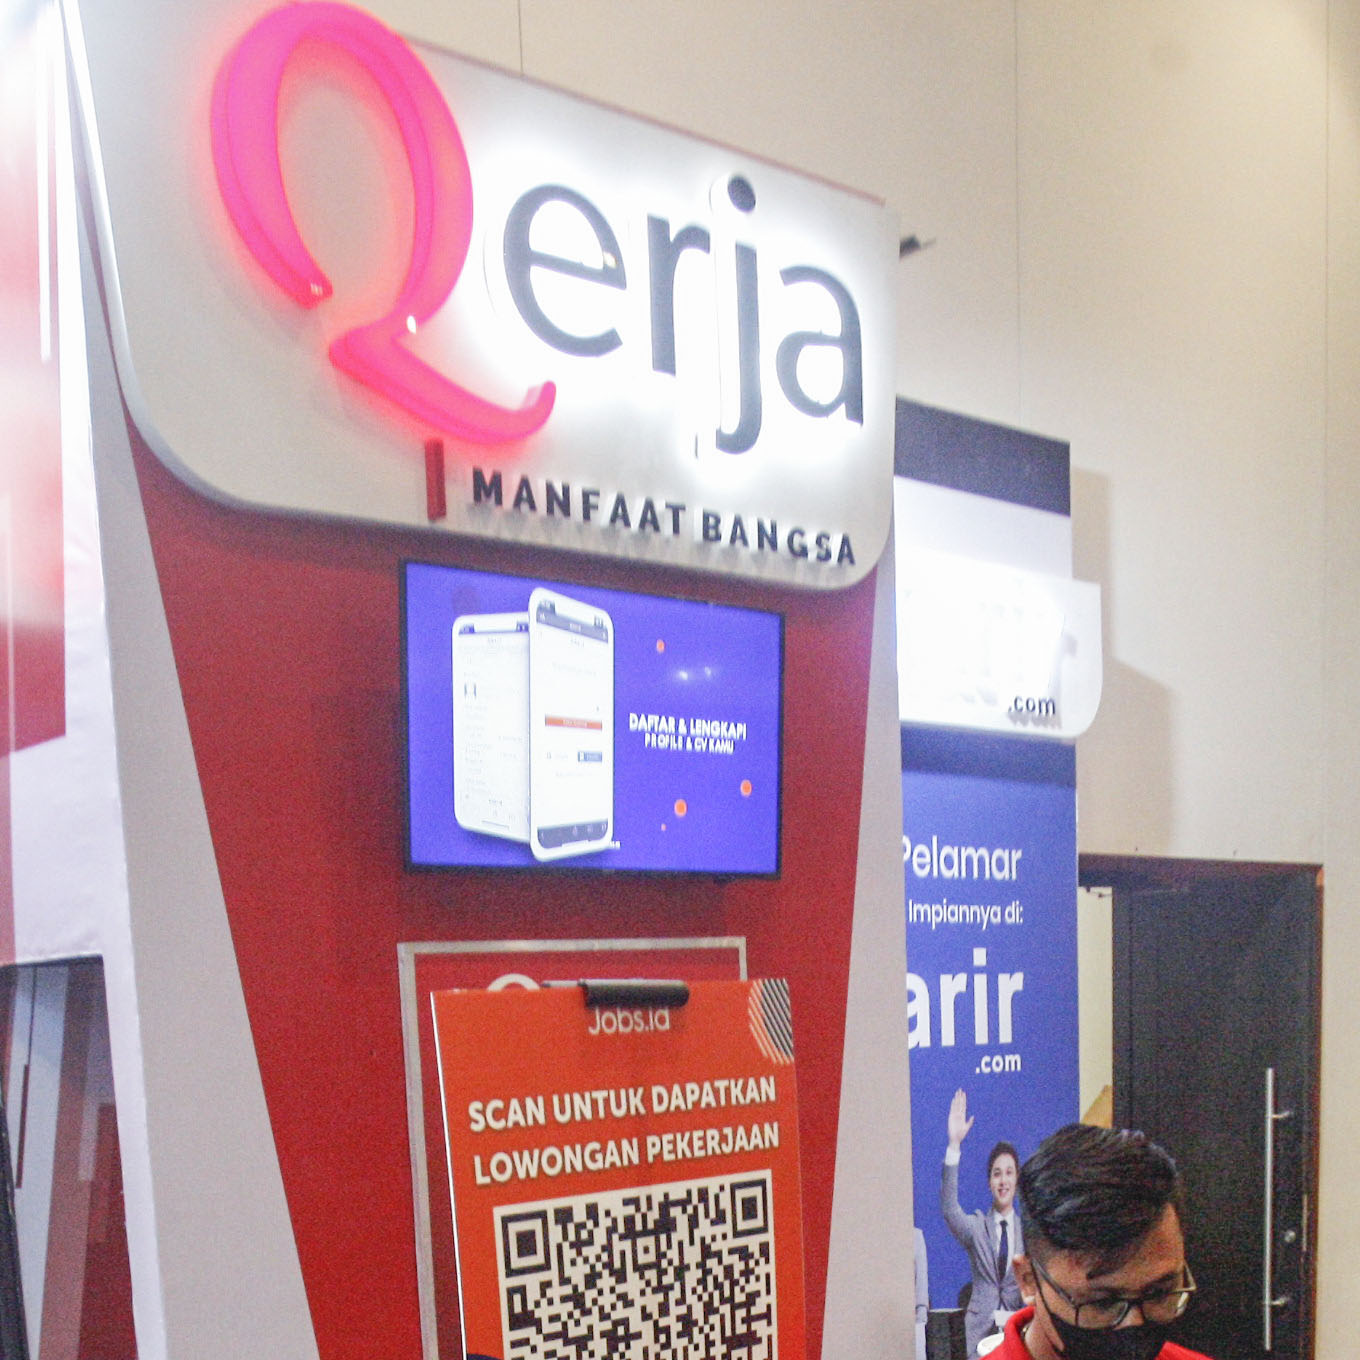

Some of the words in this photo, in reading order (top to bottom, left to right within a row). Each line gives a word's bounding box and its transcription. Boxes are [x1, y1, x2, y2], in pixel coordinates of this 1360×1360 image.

[210, 0, 864, 454] Qerja
[472, 467, 686, 535] MANFAAT
[702, 511, 857, 567] BANGSA
[629, 712, 676, 734] DAFTAR
[689, 717, 747, 742] LENGKAPI
[1008, 695, 1057, 716] .com
[908, 899, 1001, 930] Impiannya
[1004, 901, 1024, 924] di:
[975, 1053, 1022, 1074] .com
[468, 1095, 546, 1132] SCAN
[553, 1087, 647, 1124] UNTUK
[652, 1075, 777, 1115] DAPATKAN
[474, 1139, 640, 1186] LOWONGAN
[647, 1121, 780, 1163] PEKERJAAN
